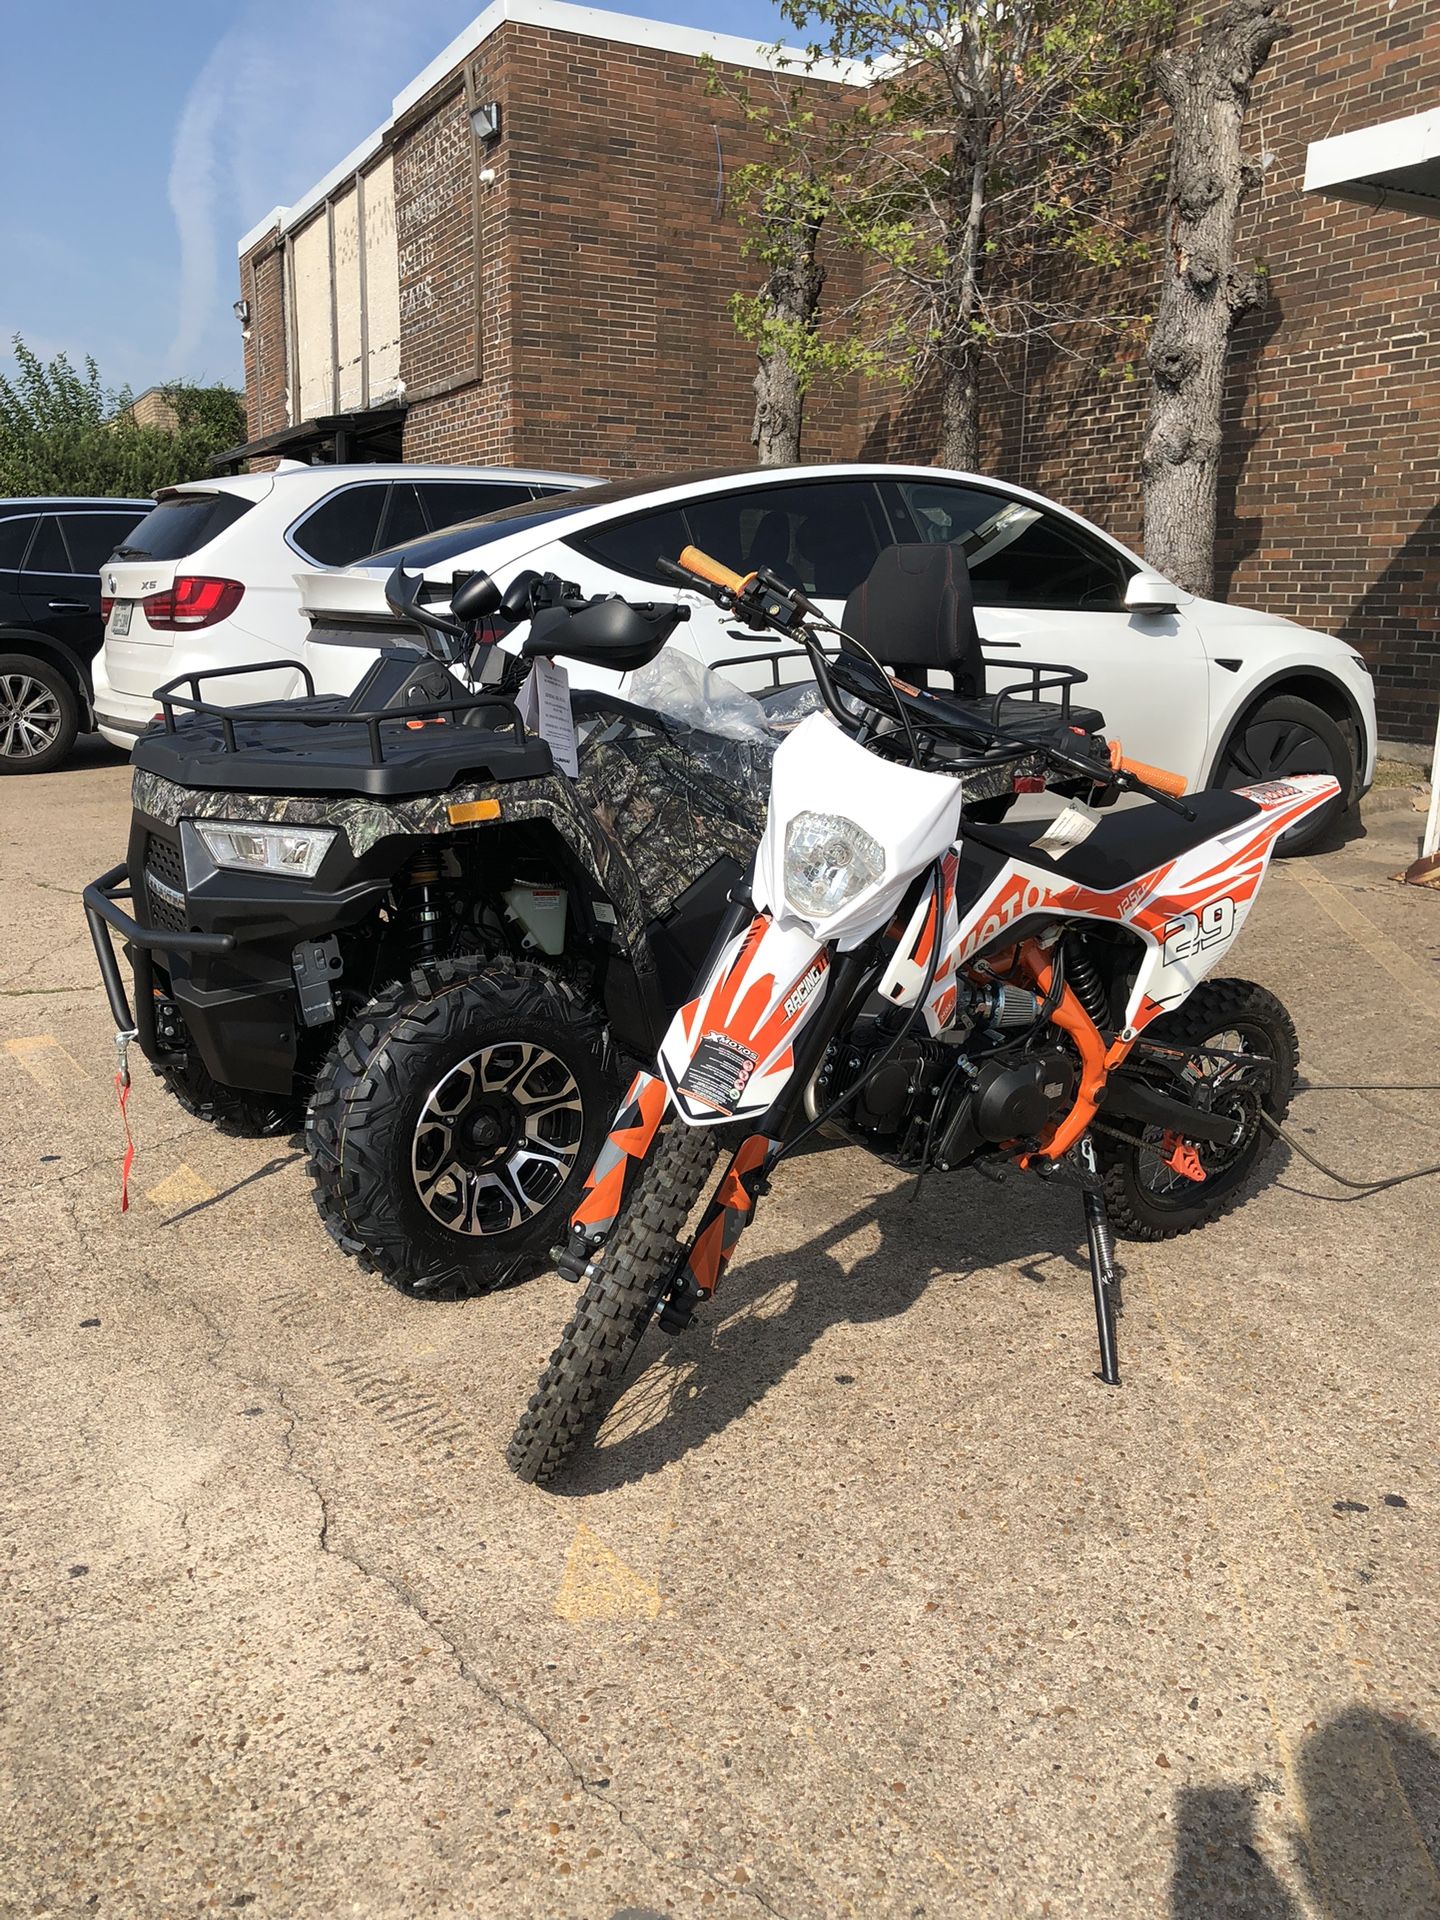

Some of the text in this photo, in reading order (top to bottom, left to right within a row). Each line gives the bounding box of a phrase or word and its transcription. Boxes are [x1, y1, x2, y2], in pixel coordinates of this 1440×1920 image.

[141, 580, 157, 590] X5
[669, 768, 698, 791] LINHAI
[1163, 896, 1236, 967] 29
[783, 965, 821, 1019] RACING
[703, 1032, 759, 1061] XMOTOS
